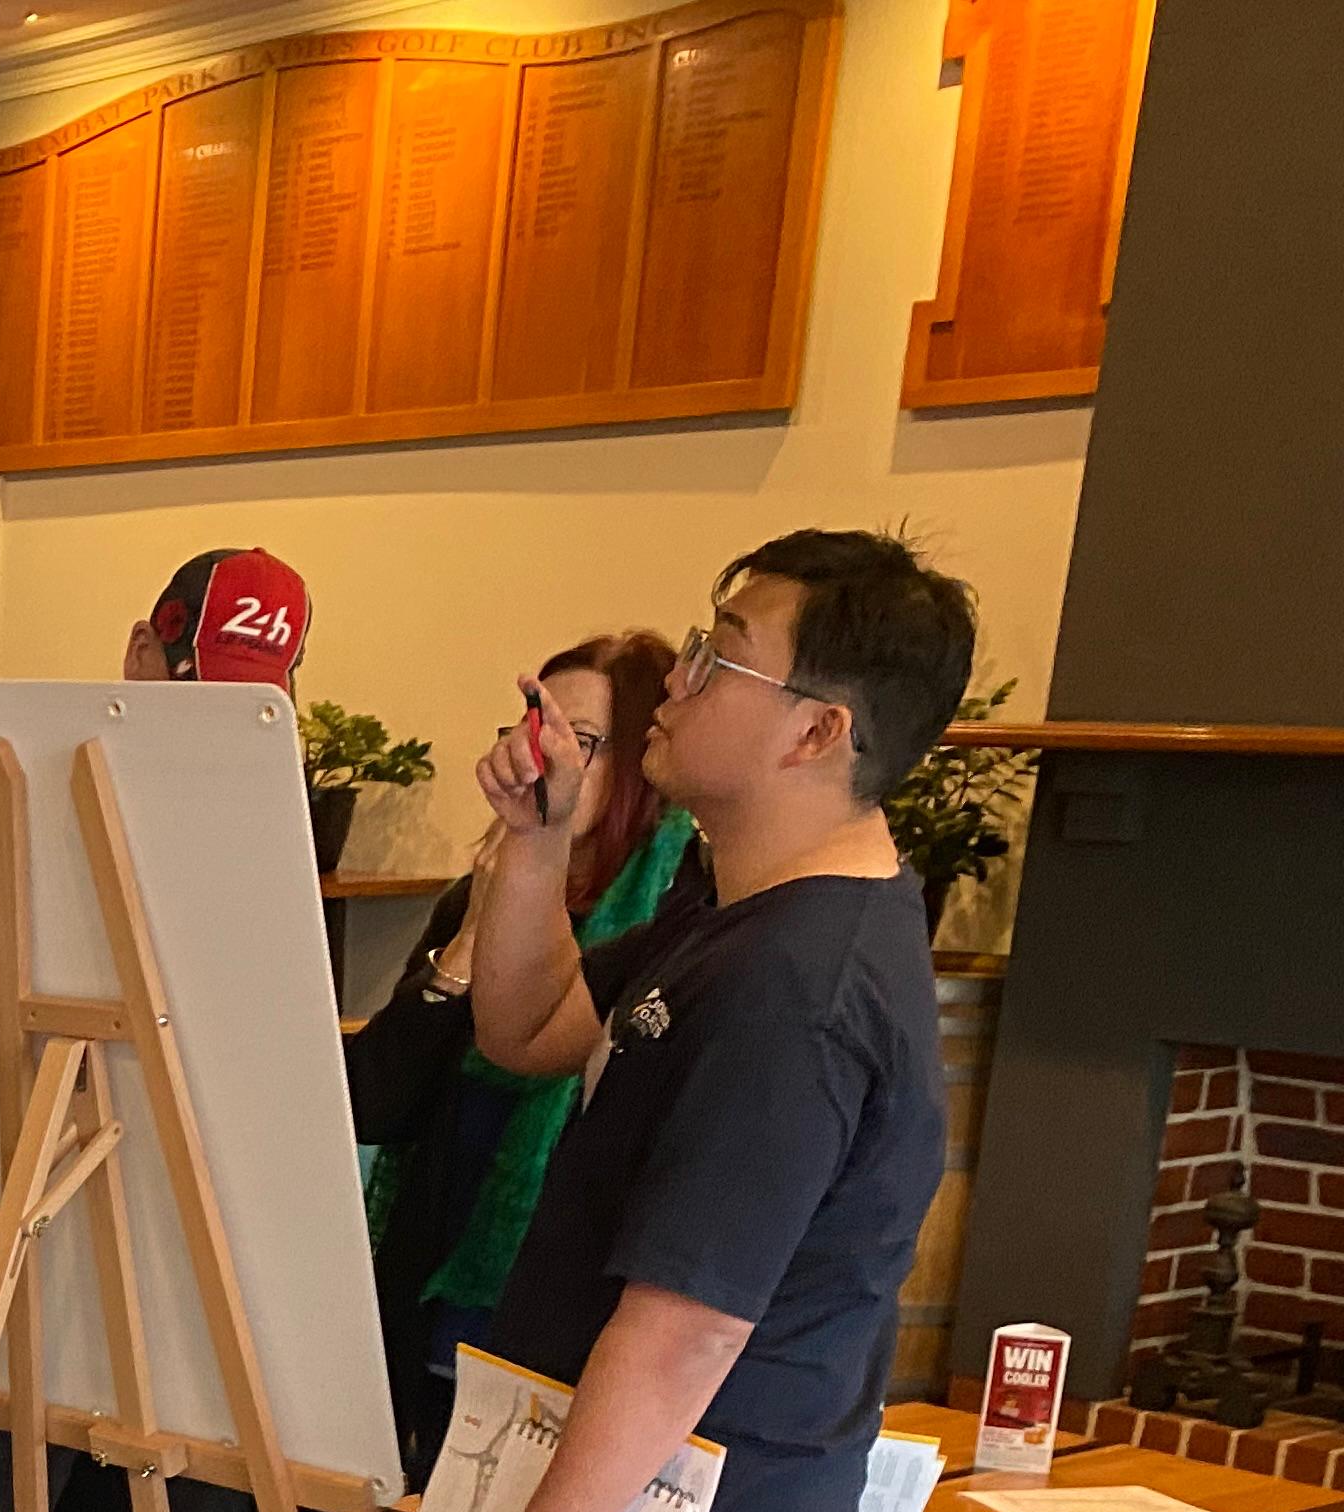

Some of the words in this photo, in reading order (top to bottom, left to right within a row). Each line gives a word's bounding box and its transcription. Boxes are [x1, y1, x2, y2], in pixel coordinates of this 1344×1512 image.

[143, 66, 217, 108] PARK
[376, 33, 464, 54] GOLF
[485, 34, 583, 58] CLUB
[1003, 1345, 1055, 1372] WIN
[1002, 1370, 1050, 1389] COOLER
